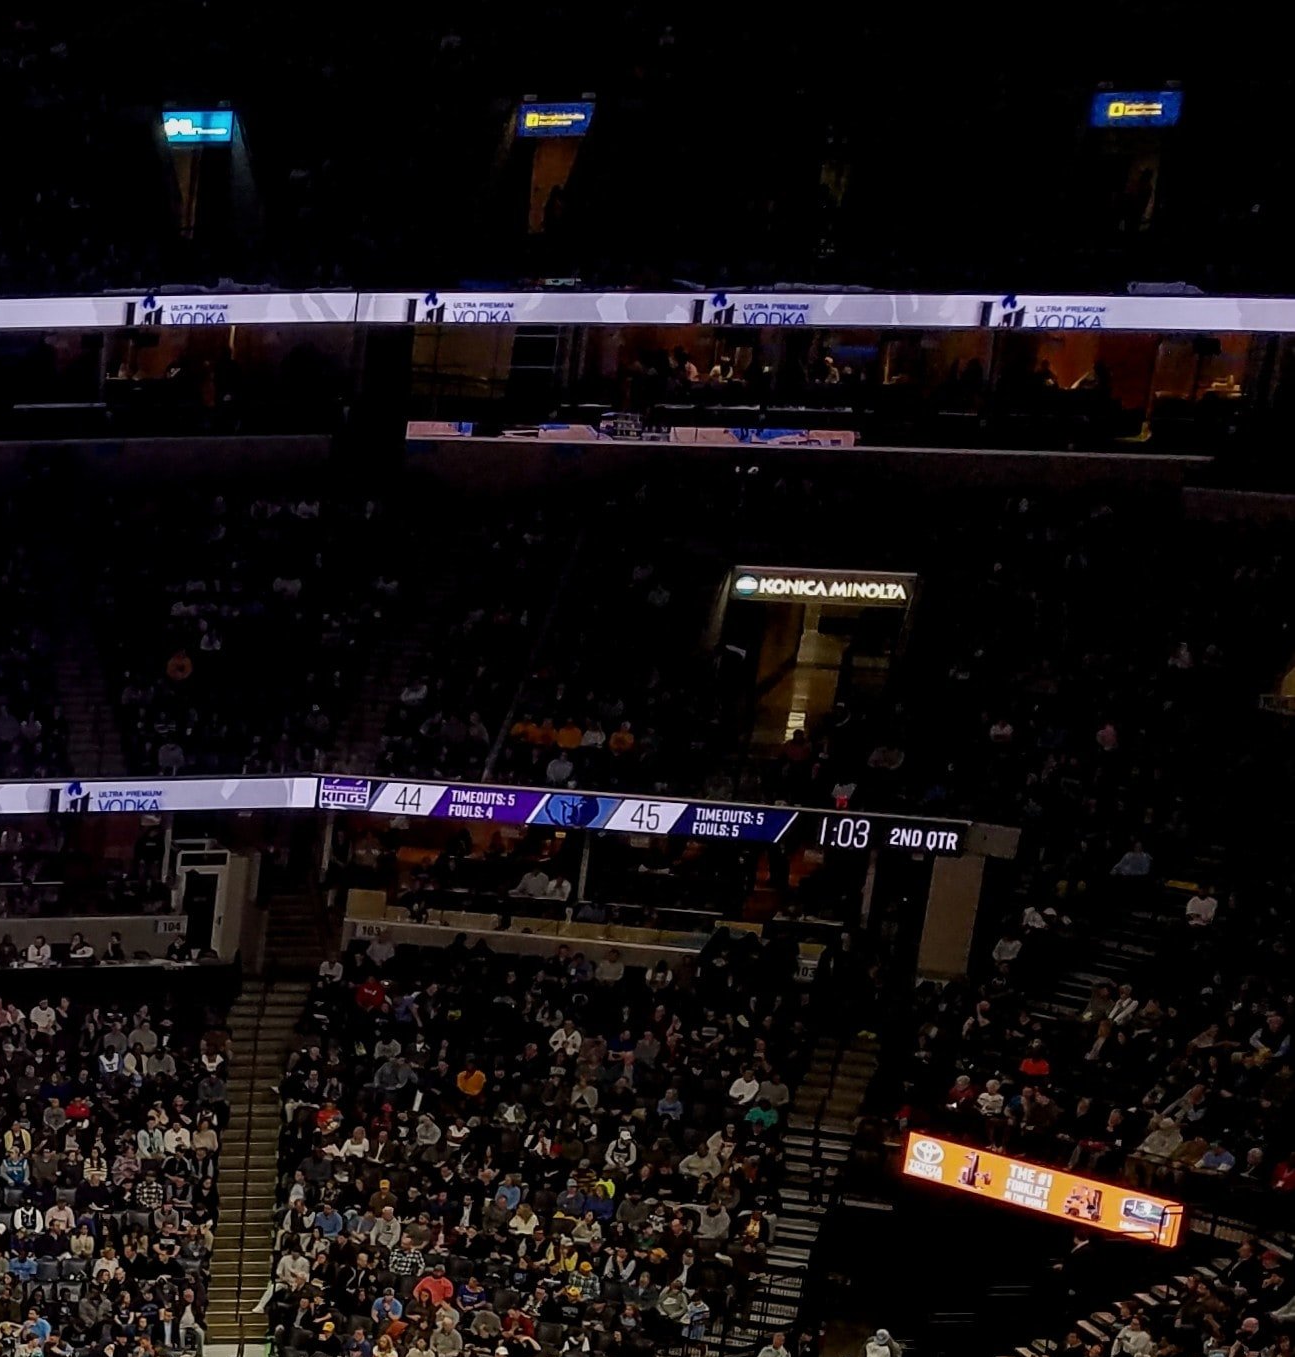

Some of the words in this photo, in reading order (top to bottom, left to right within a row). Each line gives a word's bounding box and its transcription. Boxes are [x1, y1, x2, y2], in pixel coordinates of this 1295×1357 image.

[743, 312, 806, 325] VODKA
[1034, 314, 1101, 328] VODKA
[759, 577, 828, 598] KONICA
[828, 579, 907, 600] MINOLTA
[98, 799, 160, 811] VODKA
[320, 791, 369, 806] KINGS
[394, 786, 422, 812] 44
[450, 789, 507, 807] TIMEOUTS:
[508, 794, 516, 806] 5
[448, 804, 484, 819] FOULS:
[485, 807, 493, 819] 4
[629, 803, 661, 831] 45
[695, 807, 755, 826] TIMEOUTS:
[756, 812, 765, 826] 5
[692, 822, 730, 837] FOULS:
[730, 824, 740, 837] 5
[819, 816, 871, 849] 1:03
[889, 828, 924, 848] 2ND
[925, 830, 958, 851] QTR
